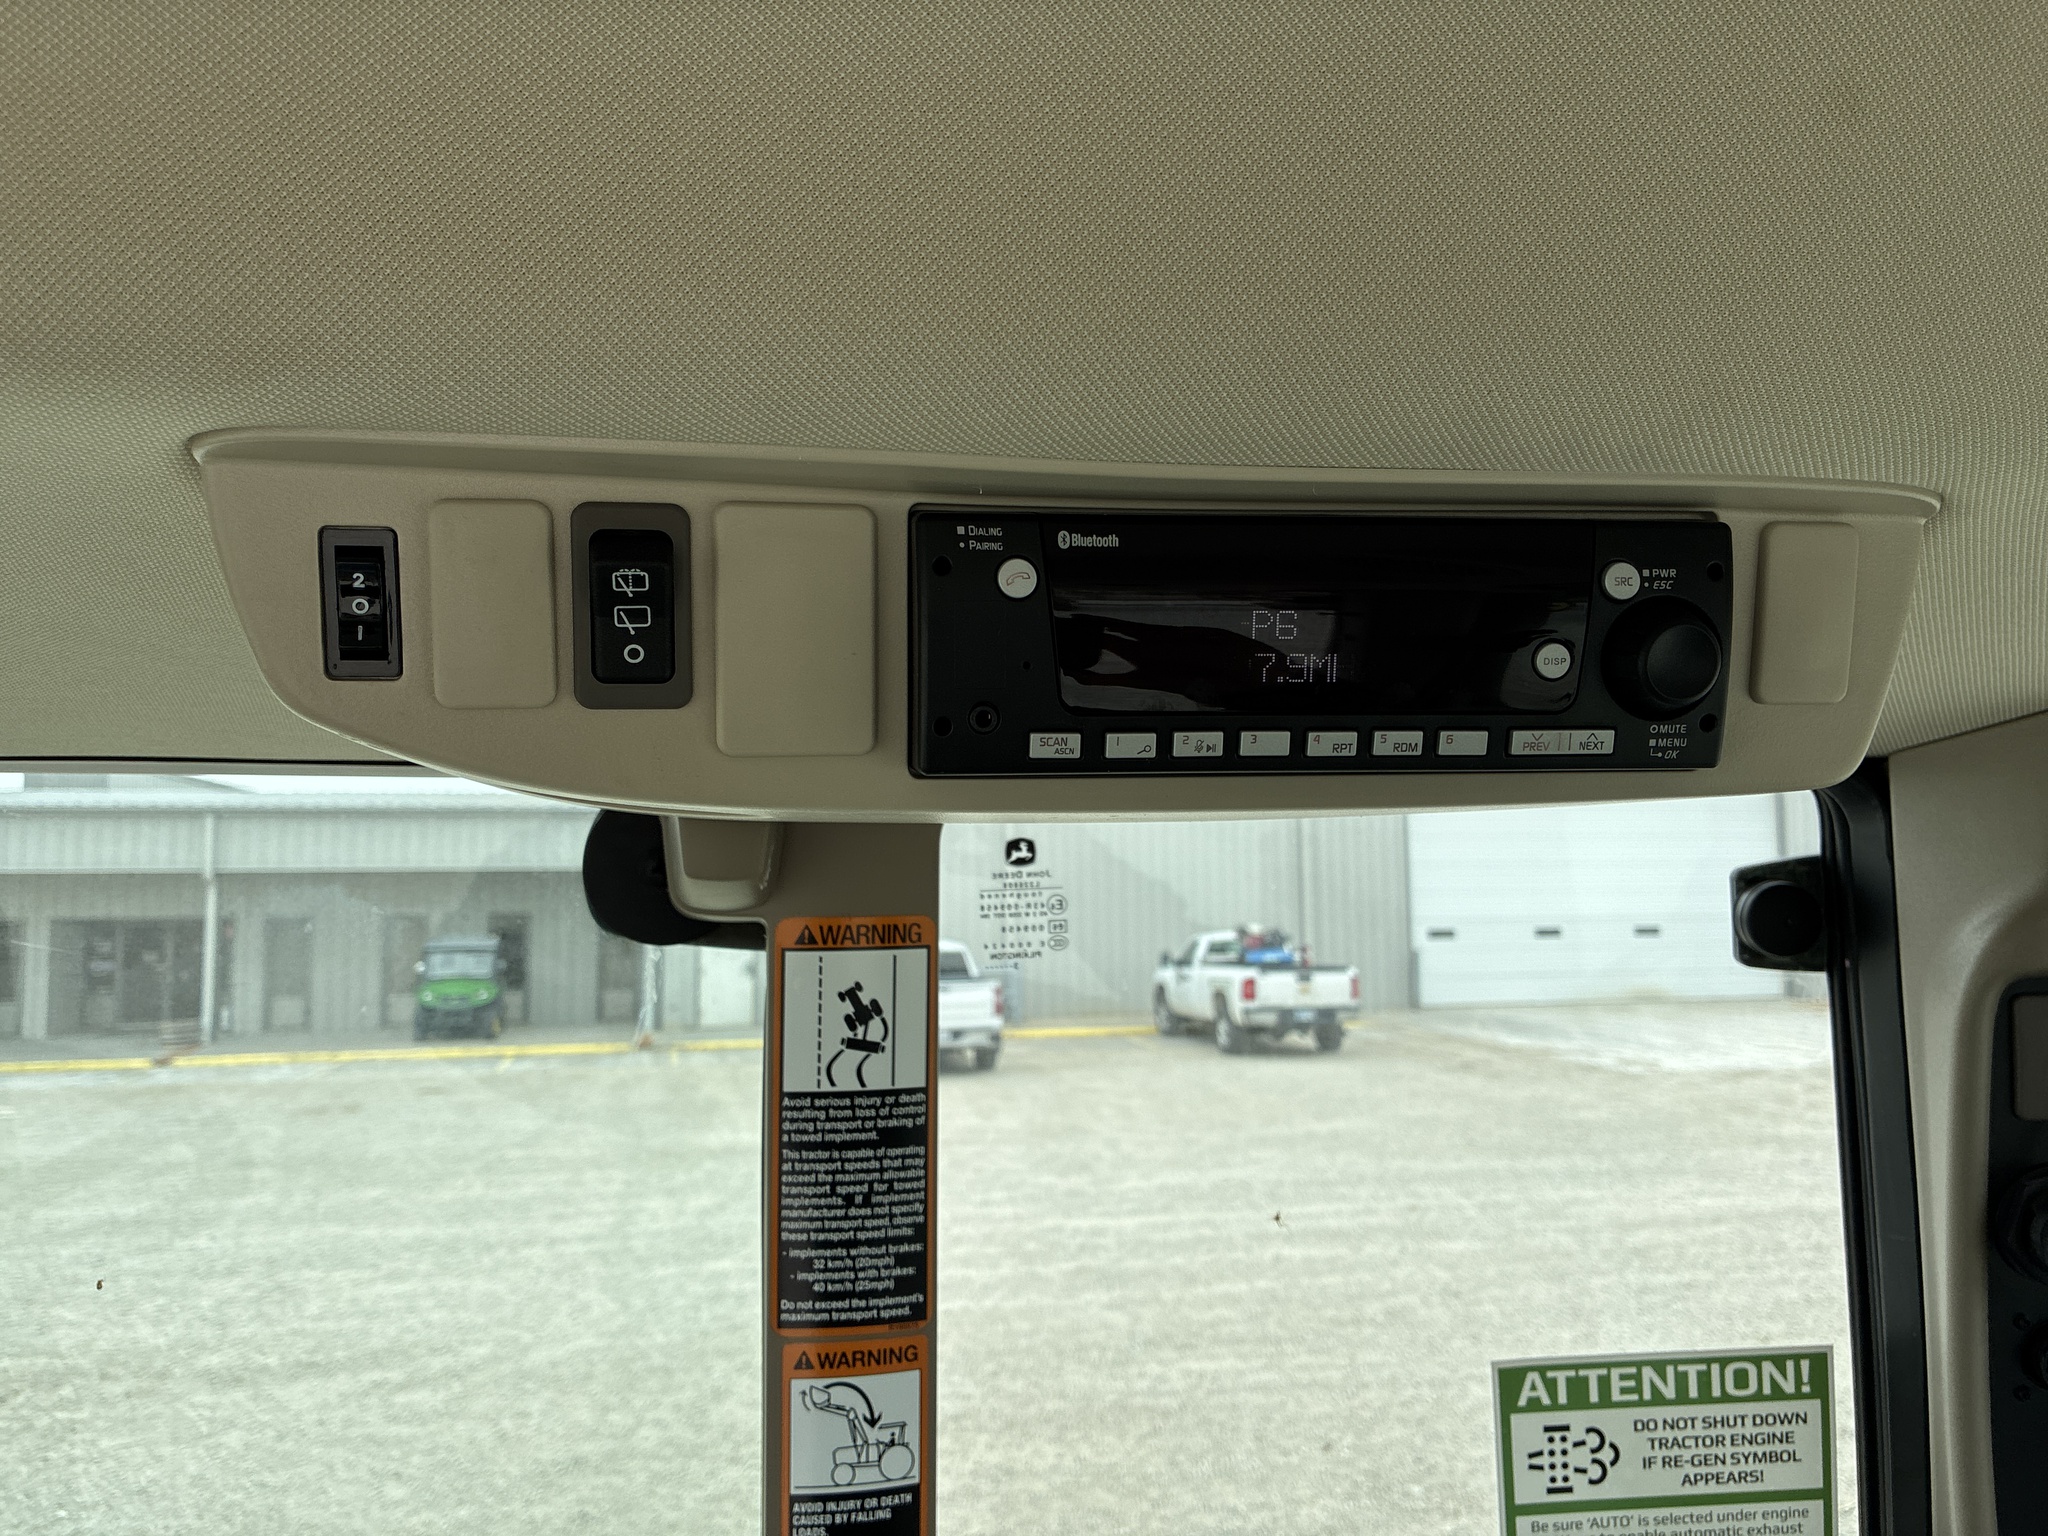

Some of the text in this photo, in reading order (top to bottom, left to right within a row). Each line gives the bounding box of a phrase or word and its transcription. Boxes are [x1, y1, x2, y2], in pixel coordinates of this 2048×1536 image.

[968, 525, 1002, 536] DIALING
[968, 540, 1003, 550] PAIRING
[1072, 534, 1119, 548] Bluetooth
[1652, 569, 1676, 578] PWR
[352, 573, 365, 588] 2
[1614, 577, 1633, 587] SRC
[1652, 580, 1674, 590] ESC
[1252, 610, 1298, 640] P6
[1543, 657, 1567, 666] DISP
[1659, 724, 1686, 734] MUTE
[1039, 737, 1068, 747] SCAN
[1182, 736, 1189, 745] 2
[1250, 735, 1257, 744] 3
[1312, 735, 1320, 745] 4
[1380, 735, 1387, 744] 5
[1446, 735, 1453, 744] 6
[1658, 738, 1687, 747] MENU
[1054, 747, 1074, 755] ASCN
[1332, 743, 1353, 753] RPT
[1393, 743, 1418, 753] RDM
[1522, 742, 1551, 751] PREV
[1579, 741, 1605, 751] NEXT
[1665, 749, 1679, 759] OK
[819, 923, 921, 945] WARNING
[784, 1097, 811, 1106] Avoid
[814, 1097, 851, 1106] serious
[884, 1096, 895, 1104] or
[782, 1104, 926, 1120] resulting from loss of control
[782, 1121, 814, 1131] during
[816, 1120, 862, 1130] transport
[877, 1118, 913, 1128] braking
[915, 1116, 925, 1125] of
[791, 1132, 822, 1141] towed
[824, 1131, 879, 1143] implement.
[782, 1146, 925, 1159] This tractor is capable of operating
[781, 1161, 792, 1171] at
[795, 1162, 842, 1172] transport
[844, 1160, 880, 1171] speeds
[882, 1158, 902, 1168] that
[782, 1168, 925, 1183] exceed the maximum allowable
[782, 1180, 925, 1195] transport speed for towed
[781, 1208, 846, 1217] manufacturer
[848, 1207, 872, 1216] does
[873, 1205, 889, 1215] not
[824, 1218, 862, 1228] transport
[781, 1232, 808, 1241] these
[810, 1230, 854, 1241] transport
[856, 1229, 885, 1239] speed
[789, 1248, 847, 1259] implements
[849, 1246, 887, 1255] without
[813, 1259, 825, 1269] 32
[827, 1258, 853, 1269] km/h
[797, 1271, 855, 1282] implements
[857, 1269, 879, 1279] with
[827, 1281, 853, 1292] km/h
[781, 1300, 795, 1309] Do
[797, 1300, 813, 1309] not
[814, 1299, 849, 1309] exceed
[851, 1298, 867, 1307] the
[781, 1311, 830, 1321] maximum
[831, 1309, 878, 1321] transport
[817, 1344, 918, 1369] WARNING
[1517, 1358, 1811, 1407] ATTENTION!
[1633, 1412, 1808, 1432] DO NOT SHUT DOWN
[1648, 1431, 1795, 1451] TRACTOR ENGINE
[1642, 1449, 1801, 1469] IF RE-GEN SYMBOL
[1681, 1470, 1764, 1487] APPEARS!
[793, 1492, 912, 1513] AVOID INJURY OR DEATH
[793, 1508, 892, 1526] CAUSED BY FALLING
[1531, 1521, 1549, 1532] Be
[1553, 1519, 1583, 1531] sure
[1638, 1514, 1649, 1526] is
[1653, 1510, 1713, 1525] selected
[1717, 1509, 1757, 1523] under
[1762, 1506, 1809, 1522] engine
[1747, 1522, 1803, 1536] exhaust
